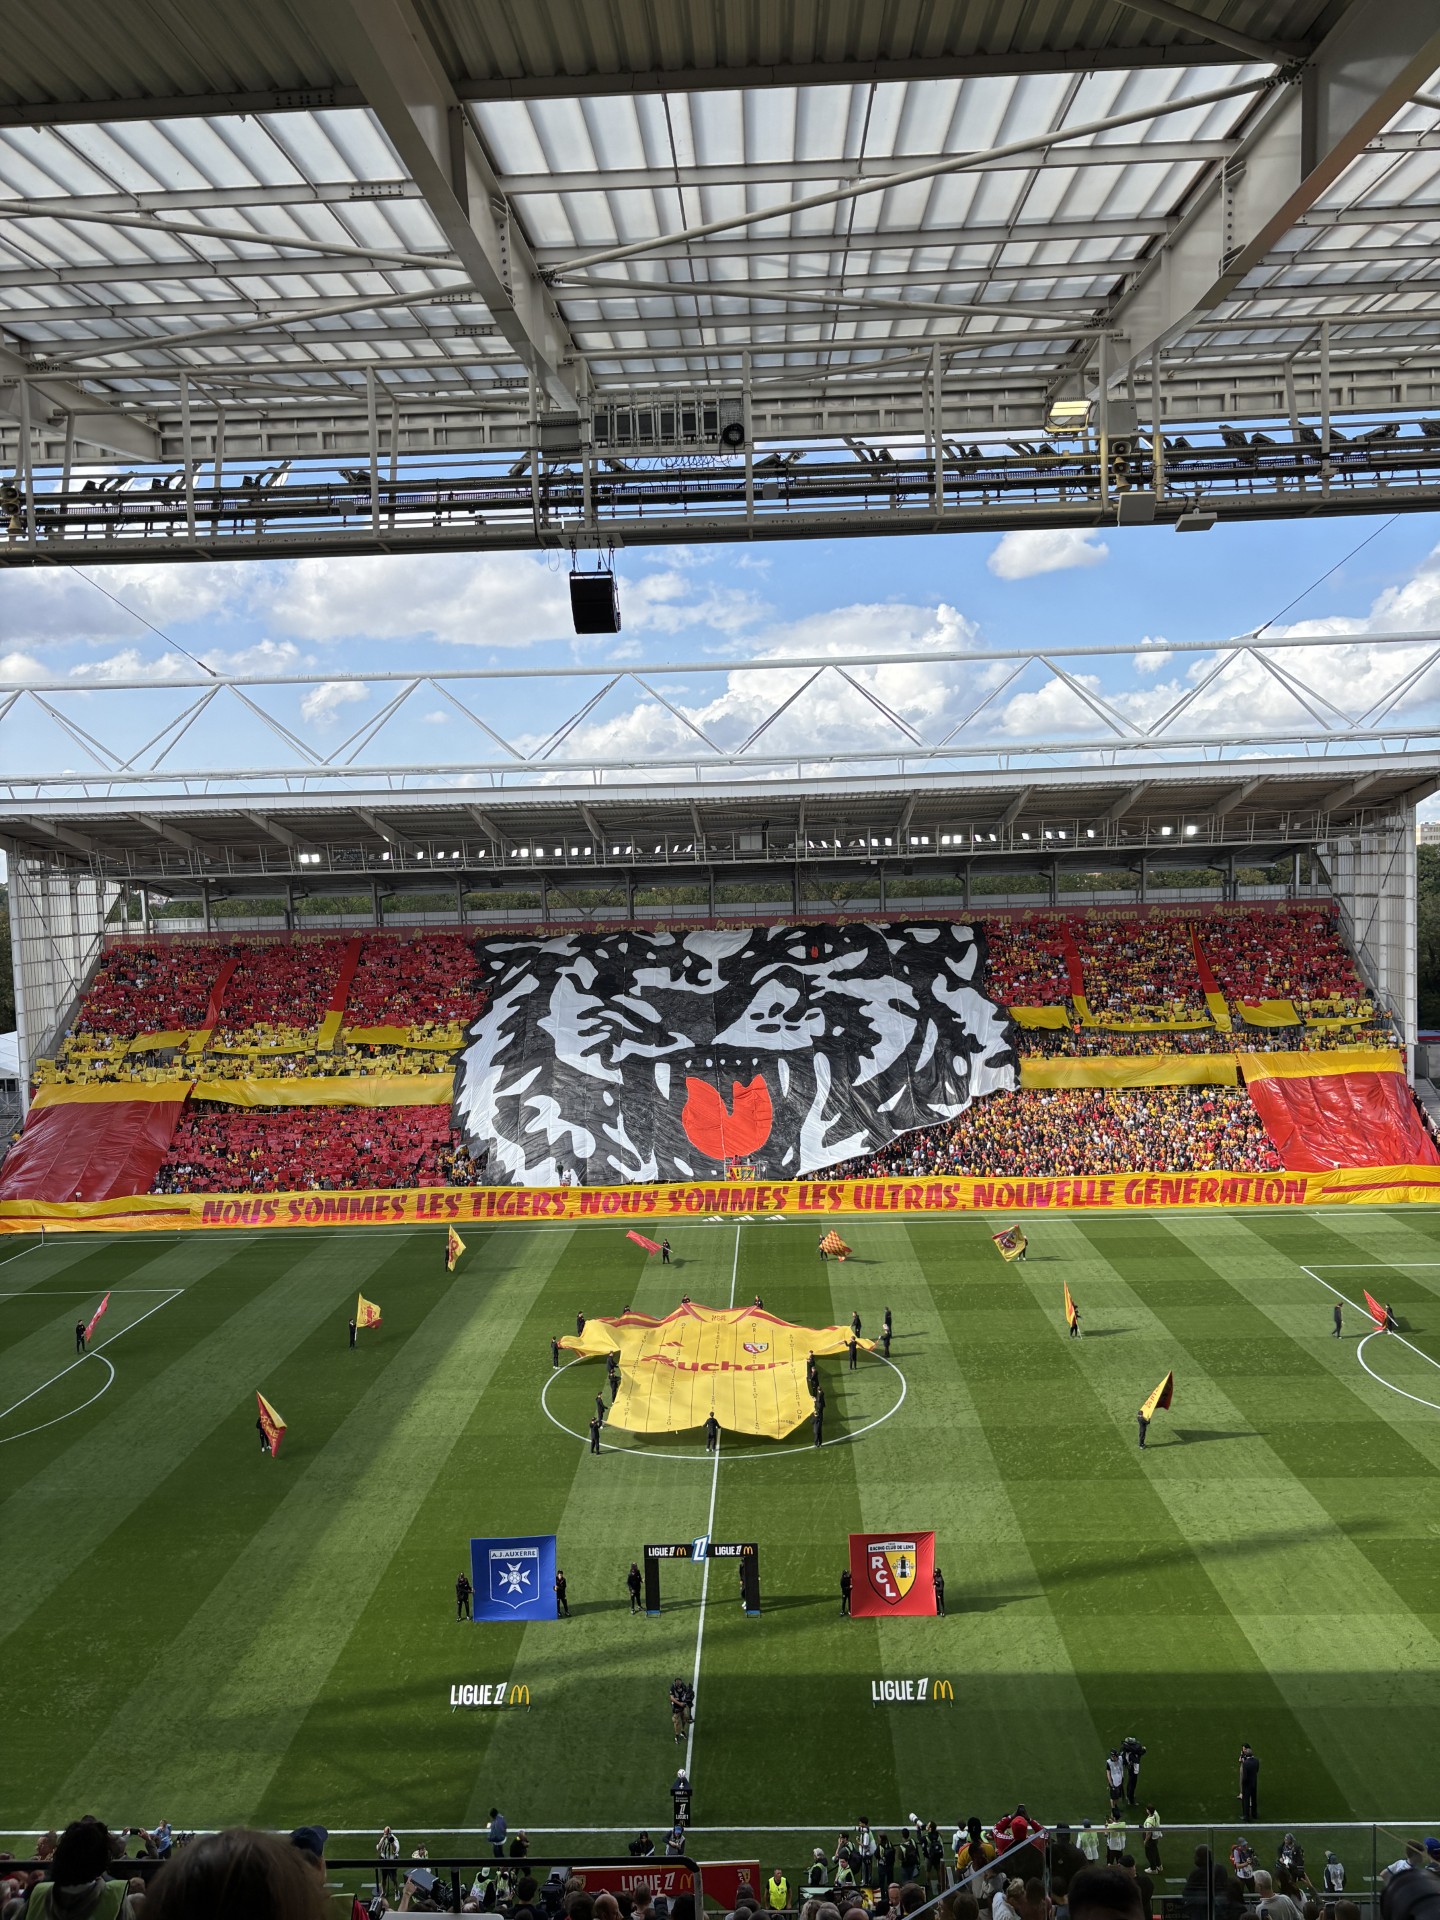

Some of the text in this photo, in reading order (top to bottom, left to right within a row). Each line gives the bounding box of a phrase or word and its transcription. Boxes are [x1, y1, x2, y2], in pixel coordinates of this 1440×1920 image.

[1085, 908, 1138, 920] Auchan
[1149, 906, 1202, 919] Auchan
[201, 1198, 280, 1225] NOUS
[288, 1194, 407, 1224] SOMMES
[415, 1192, 460, 1220] LES
[580, 1189, 659, 1215] NOUS
[667, 1185, 790, 1213] SOMMES
[797, 1183, 845, 1211] LES
[973, 1178, 1116, 1209] NOUVELLE
[648, 1546, 668, 1557] LIGUE
[715, 1545, 735, 1556] LIGUE
[450, 1684, 493, 1705] LIGUE
[872, 1680, 915, 1701] LIGUE
